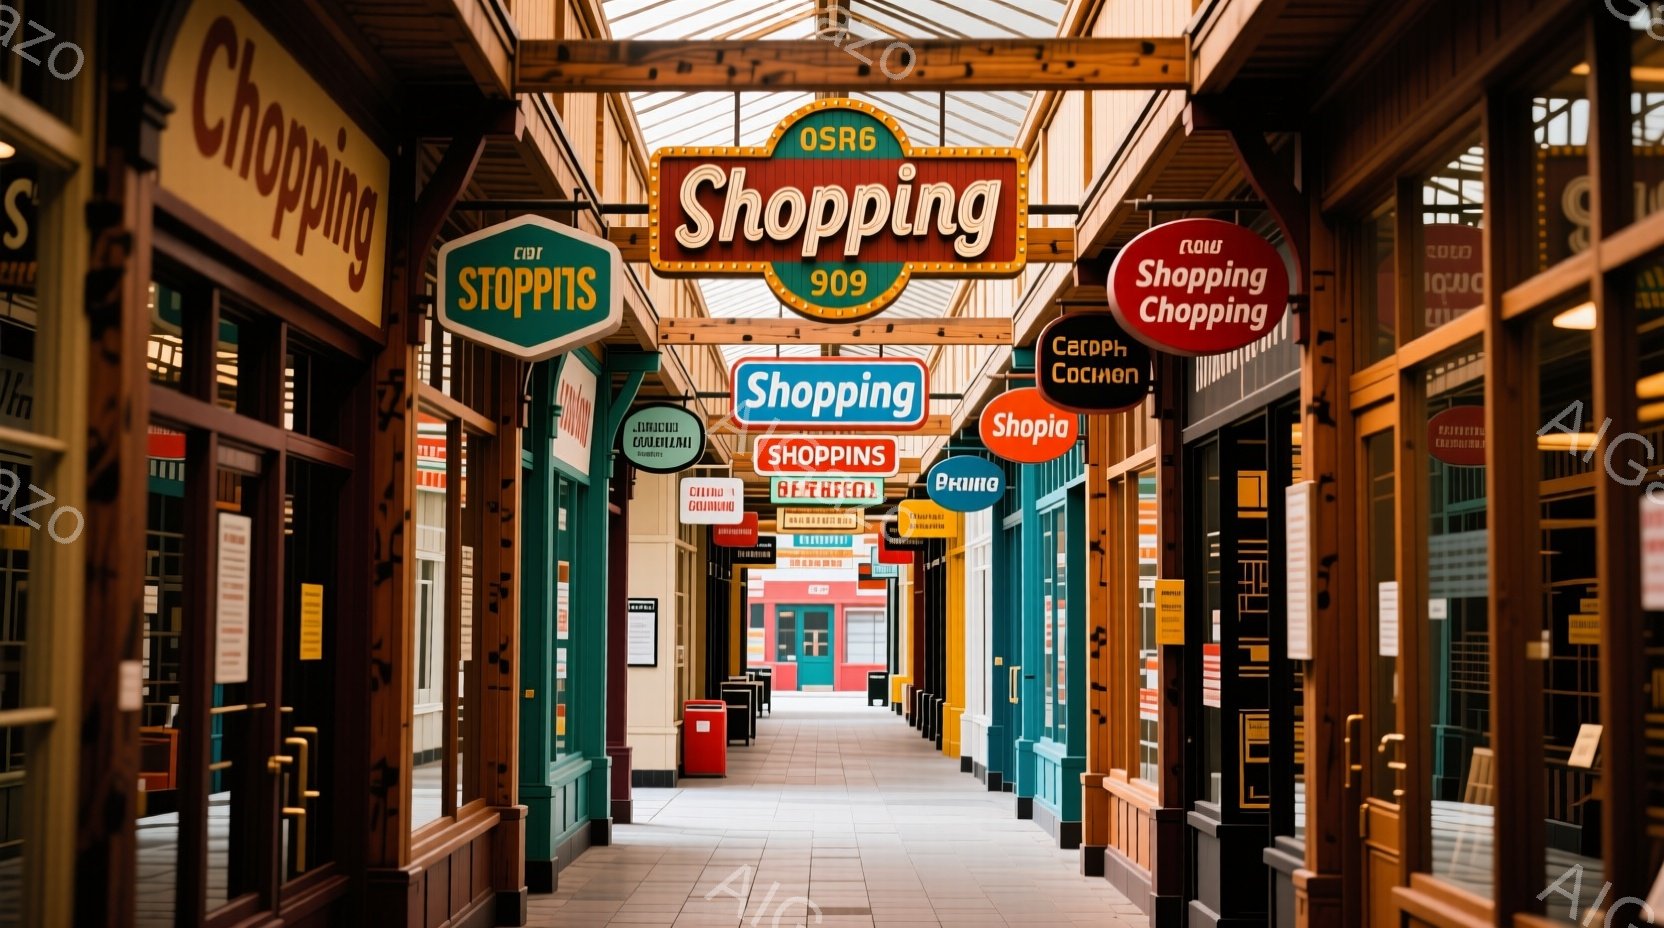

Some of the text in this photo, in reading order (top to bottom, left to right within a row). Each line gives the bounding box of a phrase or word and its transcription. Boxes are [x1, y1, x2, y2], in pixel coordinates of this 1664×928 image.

[192, 15, 378, 293] Chopping
[675, 163, 1002, 259] Shopping
[811, 270, 867, 297] 909
[1136, 259, 1268, 295] Shopping
[1139, 296, 1268, 331] Chopping
[745, 370, 916, 418] Shopping
[767, 443, 886, 467] SHOPPINS
